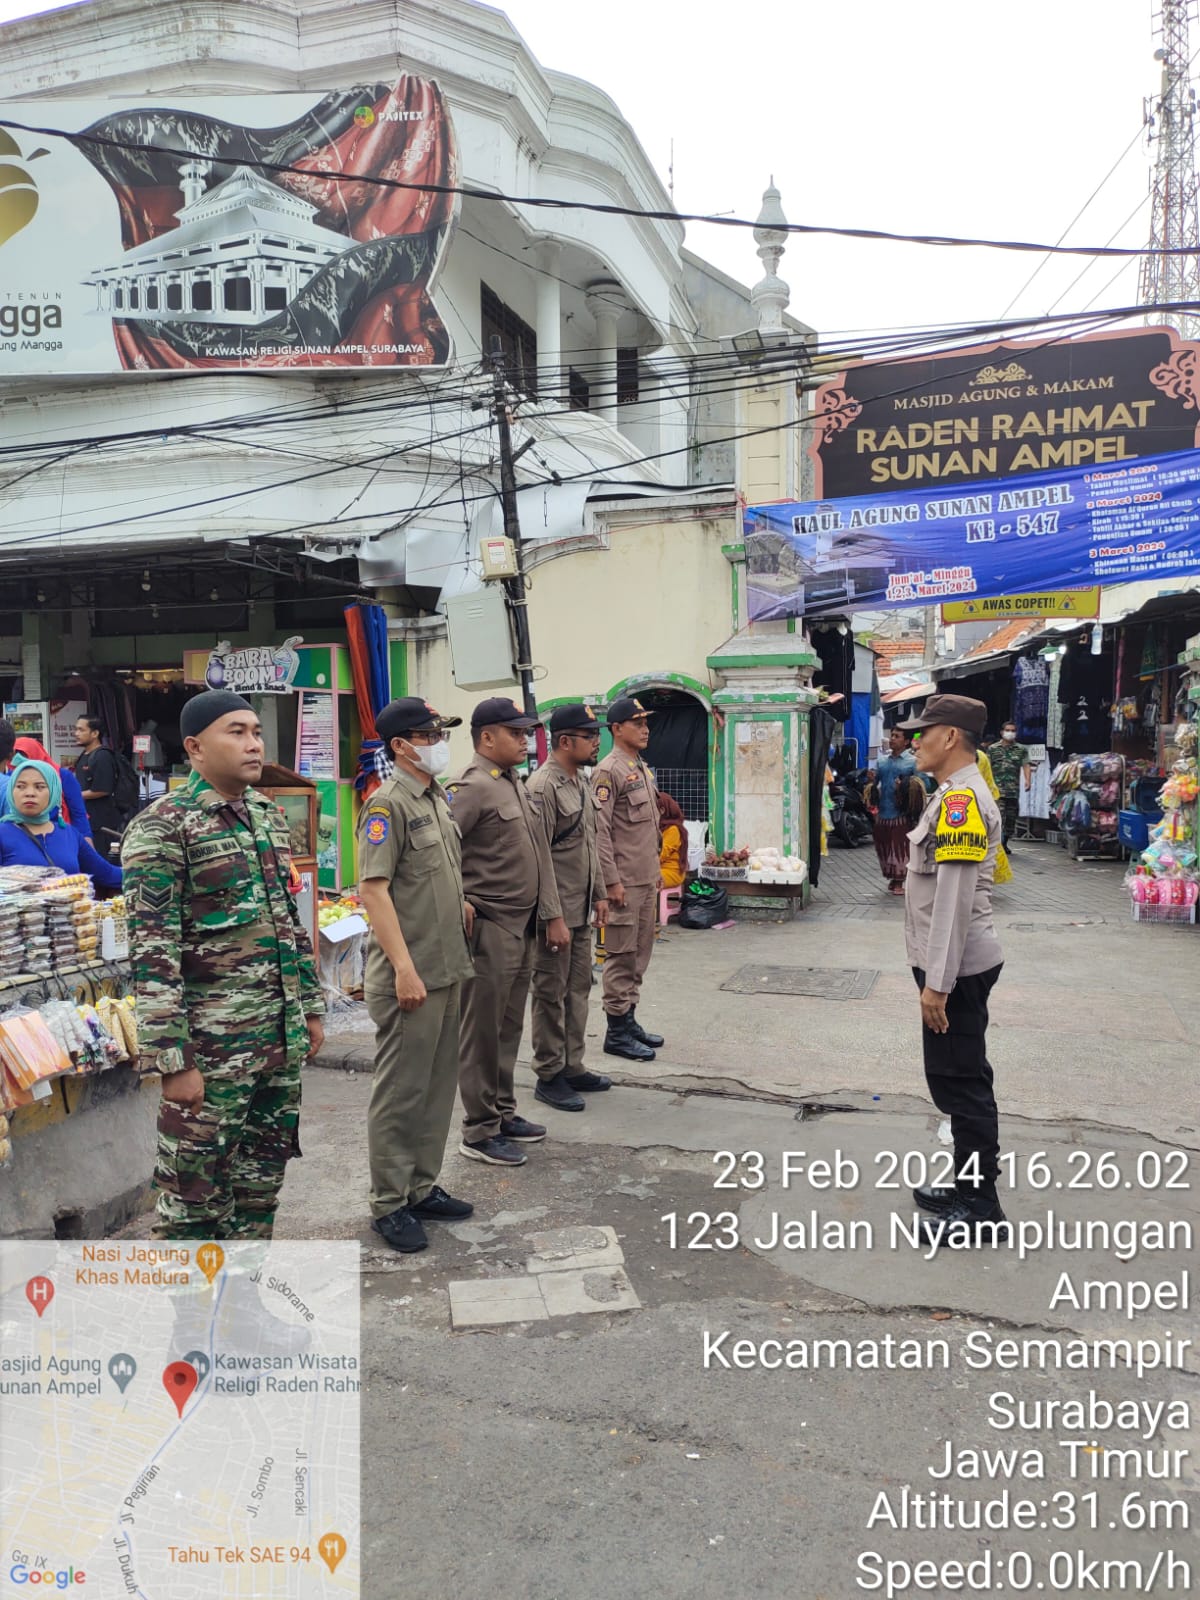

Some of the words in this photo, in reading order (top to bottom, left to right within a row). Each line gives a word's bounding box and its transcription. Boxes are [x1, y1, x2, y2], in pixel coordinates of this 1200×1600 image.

[378, 111, 423, 121] PAJITEX
[6, 292, 62, 300] TENUN
[0, 304, 62, 337] gga
[0, 342, 17, 352] ung
[21, 341, 63, 351] Mangga
[205, 346, 257, 356] KAWASAN
[260, 345, 292, 356] RELIGI
[294, 345, 331, 355] SUNAN
[333, 345, 369, 355] AMPEL
[370, 344, 425, 354] SURABAYA
[894, 394, 953, 410] MASJID
[958, 385, 1021, 404] AGUNG
[1026, 385, 1039, 397] &
[1044, 376, 1114, 395] MAKAM
[857, 416, 979, 453] RADEN
[992, 400, 1156, 441] RAHMAT
[870, 447, 997, 483] SUNAN
[1009, 435, 1138, 471] AMPEL
[1133, 492, 1162, 502] 2024
[792, 511, 843, 535] HAUL
[850, 503, 920, 528] AGUNG
[926, 495, 992, 520] SUNAN
[999, 485, 1074, 512] AMPEL
[966, 520, 995, 543] KE
[1017, 511, 1060, 536] 547
[1099, 546, 1135, 557] Maret
[1136, 541, 1166, 552] 2024
[889, 572, 924, 587] Jum'at
[933, 566, 972, 581] Minggu
[917, 583, 948, 597] Maret
[949, 579, 977, 593] 2024
[983, 599, 1011, 611] AWAS
[1014, 597, 1055, 609] COPET!!
[223, 649, 273, 669] BABA
[223, 666, 276, 684] BOOM
